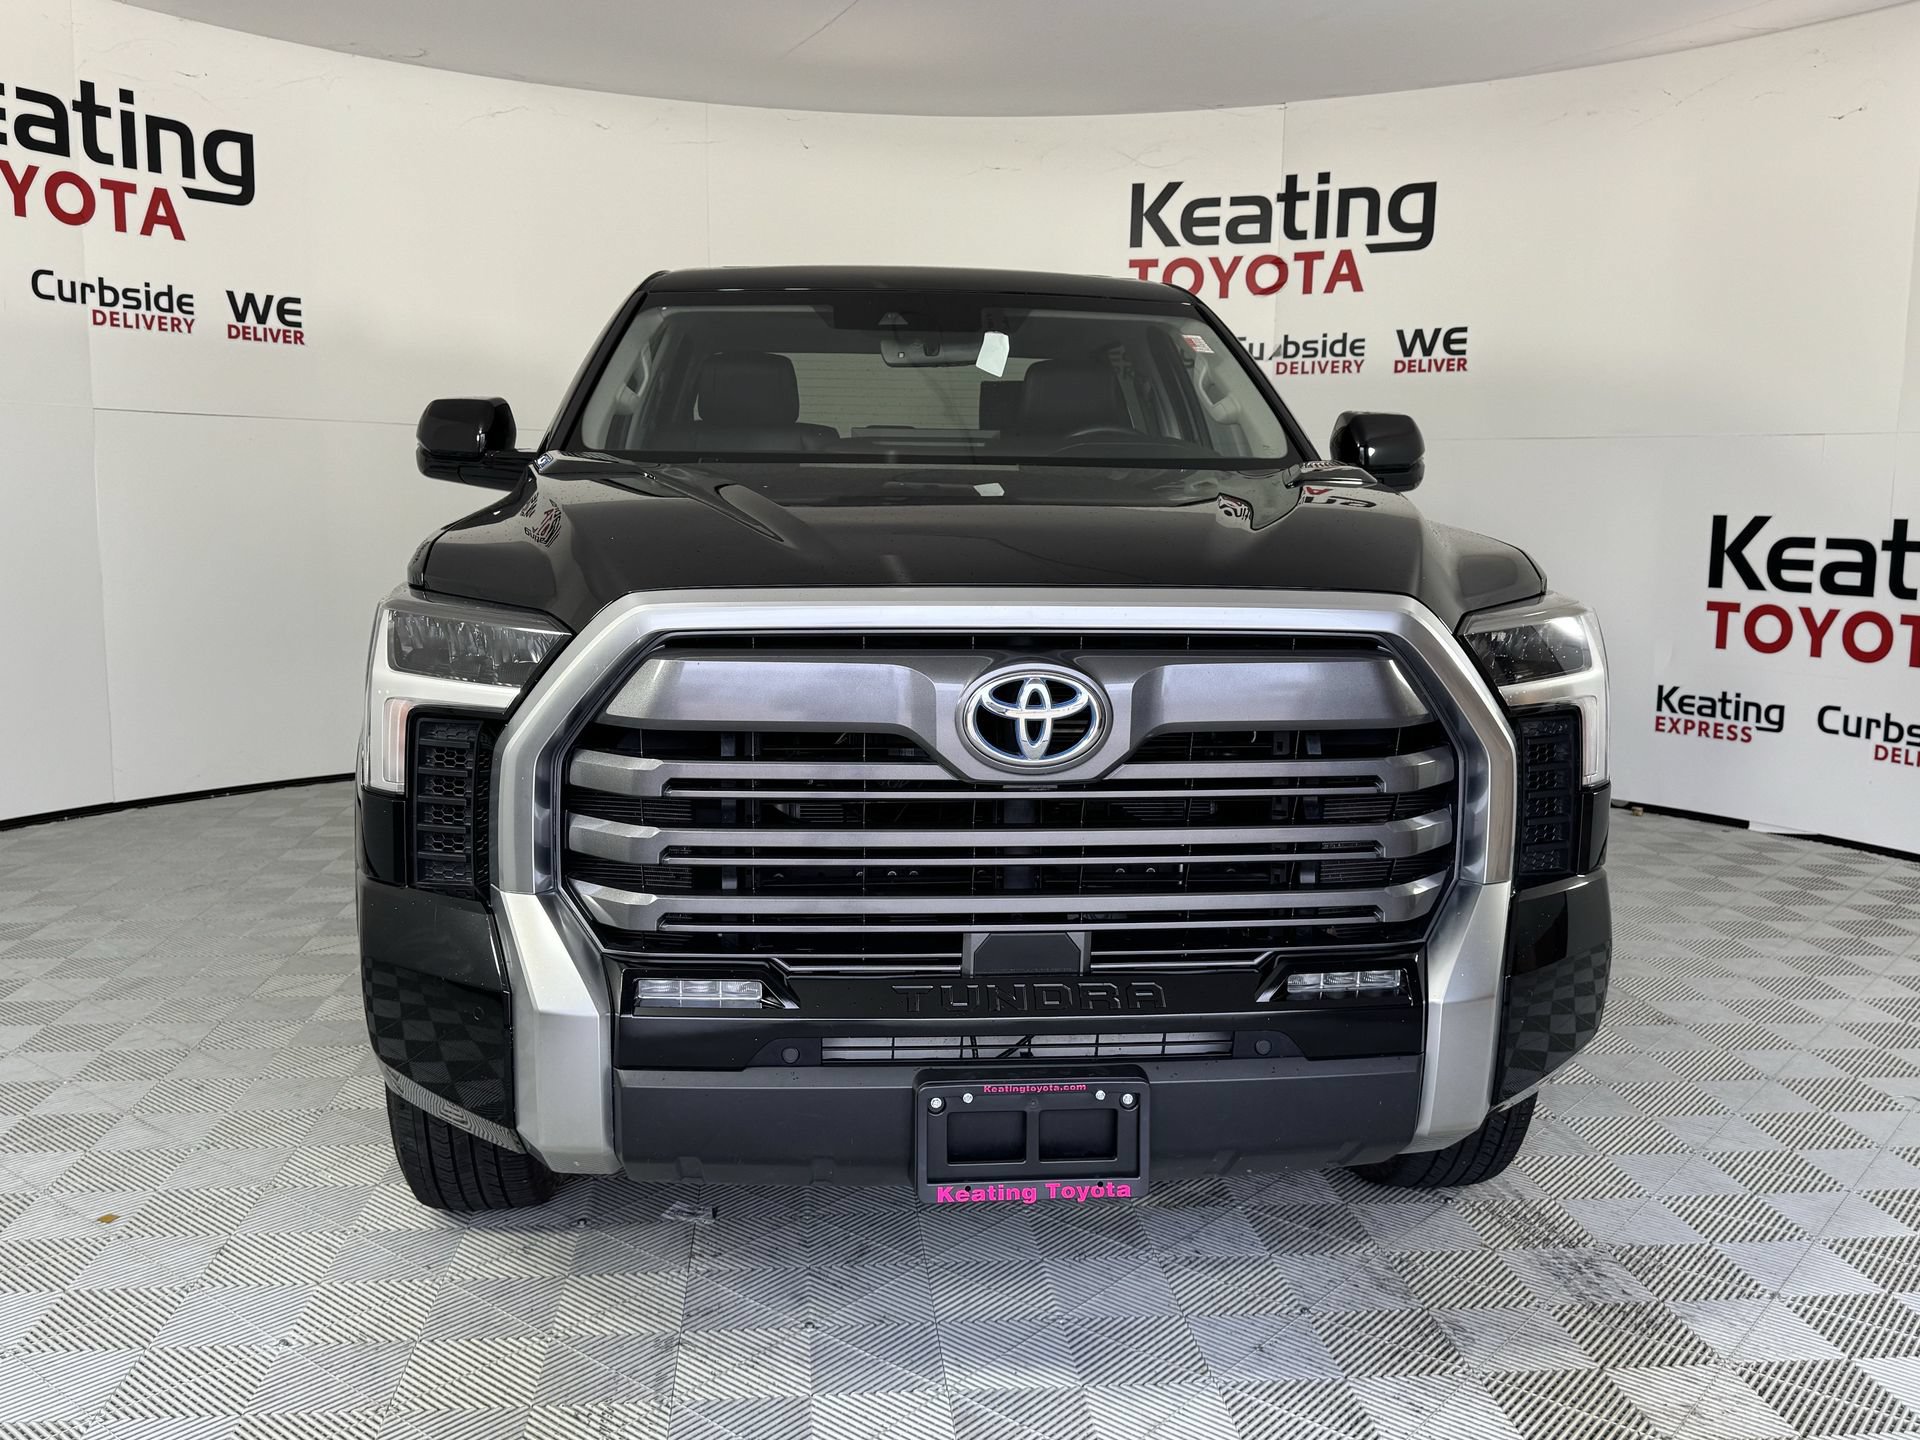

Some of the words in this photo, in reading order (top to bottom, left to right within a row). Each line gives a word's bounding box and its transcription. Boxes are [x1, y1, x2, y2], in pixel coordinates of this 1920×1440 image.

[0, 79, 255, 206] ating
[0, 158, 187, 241] YOTA
[1129, 171, 1438, 254] Keating
[1128, 249, 1364, 299] TOYOTA
[31, 269, 195, 316] Curbside
[225, 290, 303, 328] WE
[92, 309, 196, 334] DELIVERY
[227, 323, 305, 345] DELIVER
[1396, 326, 1469, 358] WE
[1275, 359, 1365, 375] DELIVERY
[1393, 358, 1468, 374] DELIVER
[1708, 514, 1920, 601] Keat
[1656, 684, 1785, 733] Keating
[1654, 715, 1753, 744] EXPRESS
[892, 982, 1167, 1012] TUNDRA
[936, 1184, 1038, 1204] Keating
[1045, 1182, 1132, 1202] Toyota
